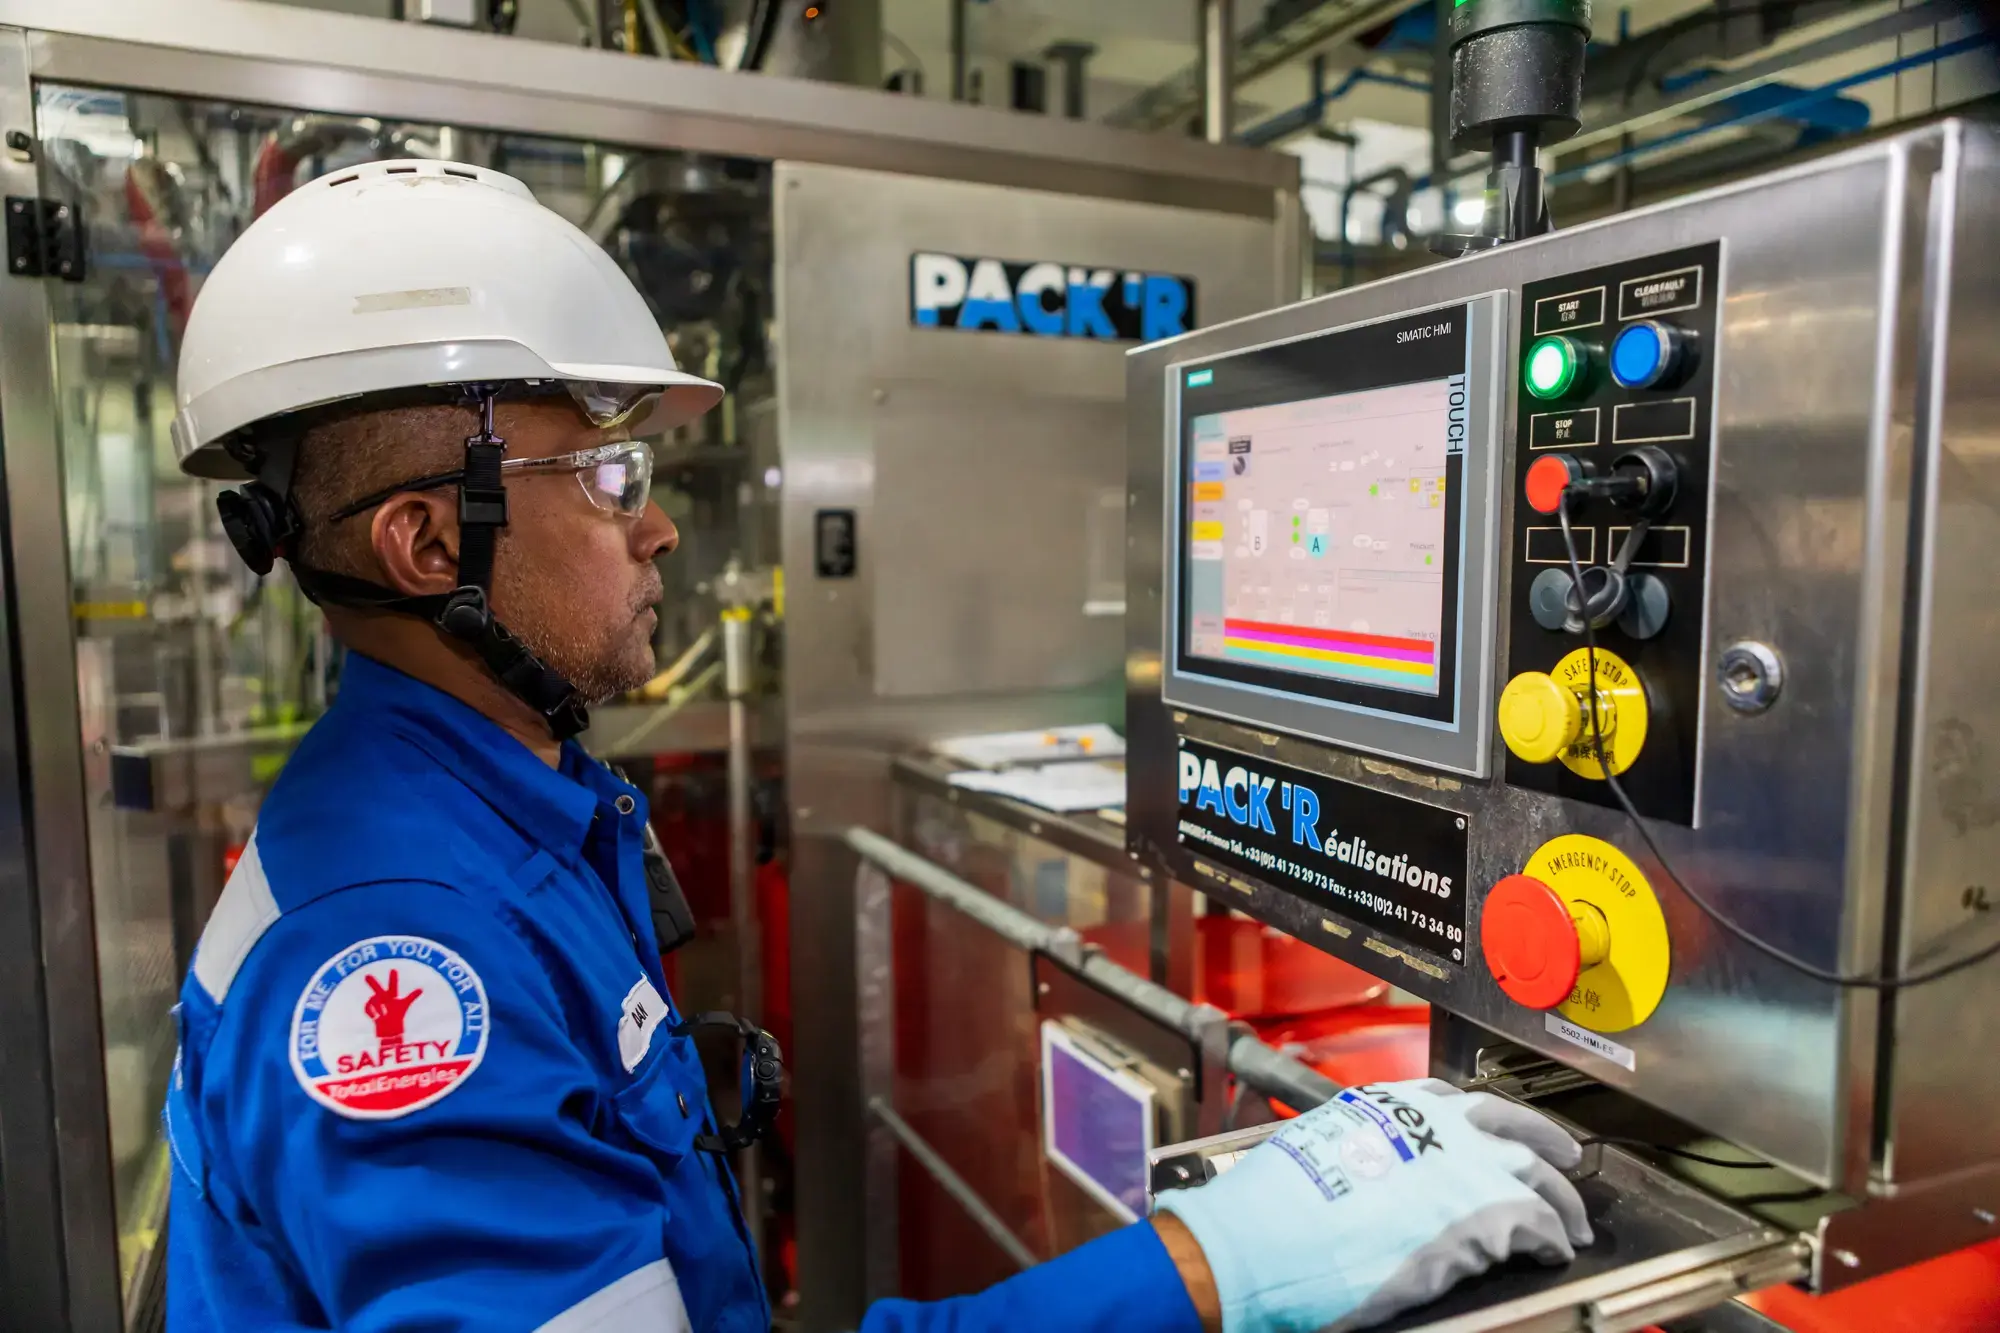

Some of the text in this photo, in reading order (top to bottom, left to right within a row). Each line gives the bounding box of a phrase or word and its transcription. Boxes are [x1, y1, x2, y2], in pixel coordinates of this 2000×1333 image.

[1558, 300, 1580, 312] START
[1396, 322, 1452, 344] SIMATIC HMI
[1448, 376, 1466, 453] TOUCH
[1555, 419, 1573, 429] STOP
[1312, 537, 1320, 552] A
[1564, 657, 1628, 687] SAFEY STOP
[1548, 851, 1636, 898] EMERGENCY STOP
[1276, 858, 1287, 873] 41
[1288, 862, 1301, 878] 73
[1302, 866, 1314, 883] 29
[1315, 872, 1328, 889] 73
[1328, 878, 1346, 897] Fax
[1394, 904, 1408, 921] 41
[1411, 910, 1427, 929] 73
[1428, 917, 1444, 936] 34
[1446, 924, 1462, 943] 80
[300, 1019, 319, 1060] FOR
[335, 944, 378, 977] FOR
[437, 957, 474, 995] FOR
[337, 1040, 452, 1075] SAFETY
[327, 1067, 459, 1100] TotalEnergies
